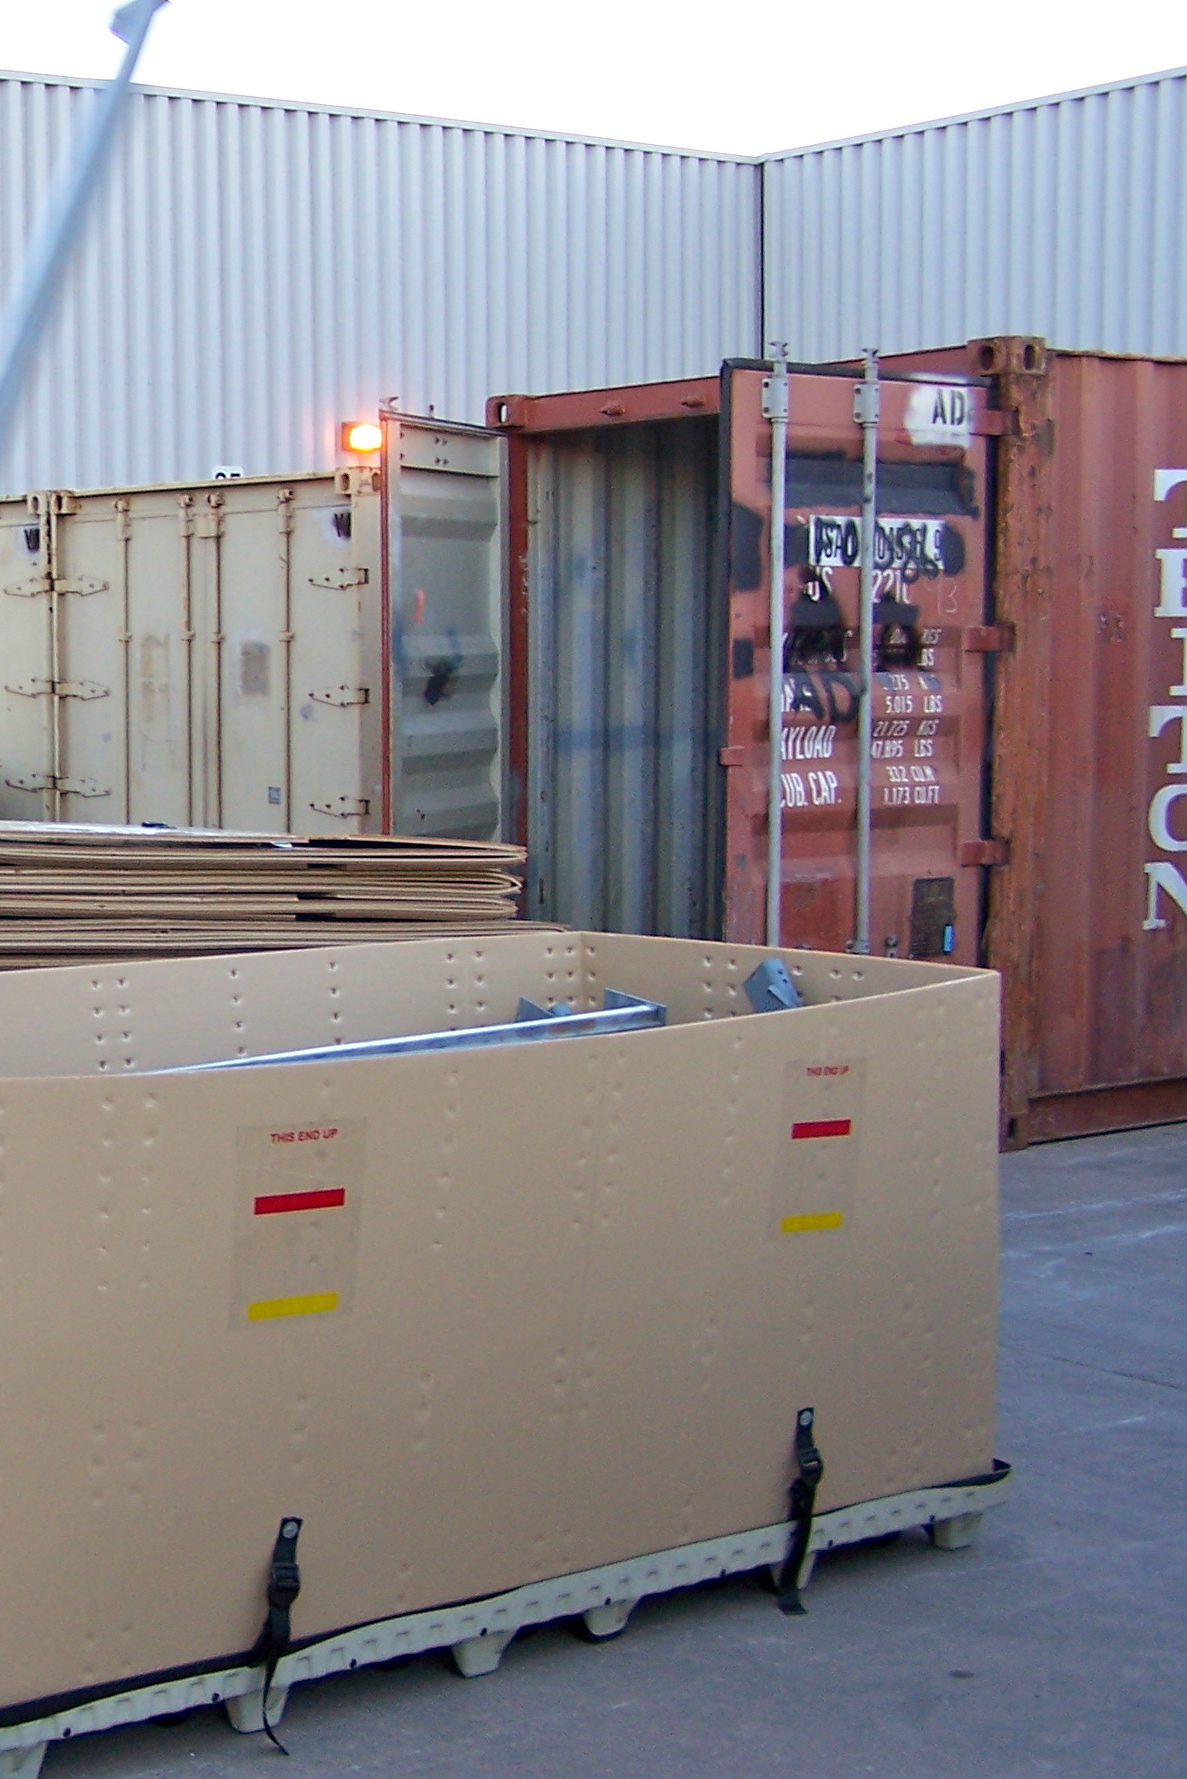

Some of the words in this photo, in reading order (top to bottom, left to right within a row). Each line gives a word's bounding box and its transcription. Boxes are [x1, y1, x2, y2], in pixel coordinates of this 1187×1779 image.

[932, 388, 965, 425] AD
[807, 770, 842, 806] CAP.
[824, 1066, 839, 1076] END
[271, 1132, 295, 1143] THIS
[298, 1130, 320, 1141] END
[323, 1128, 338, 1139] UP
